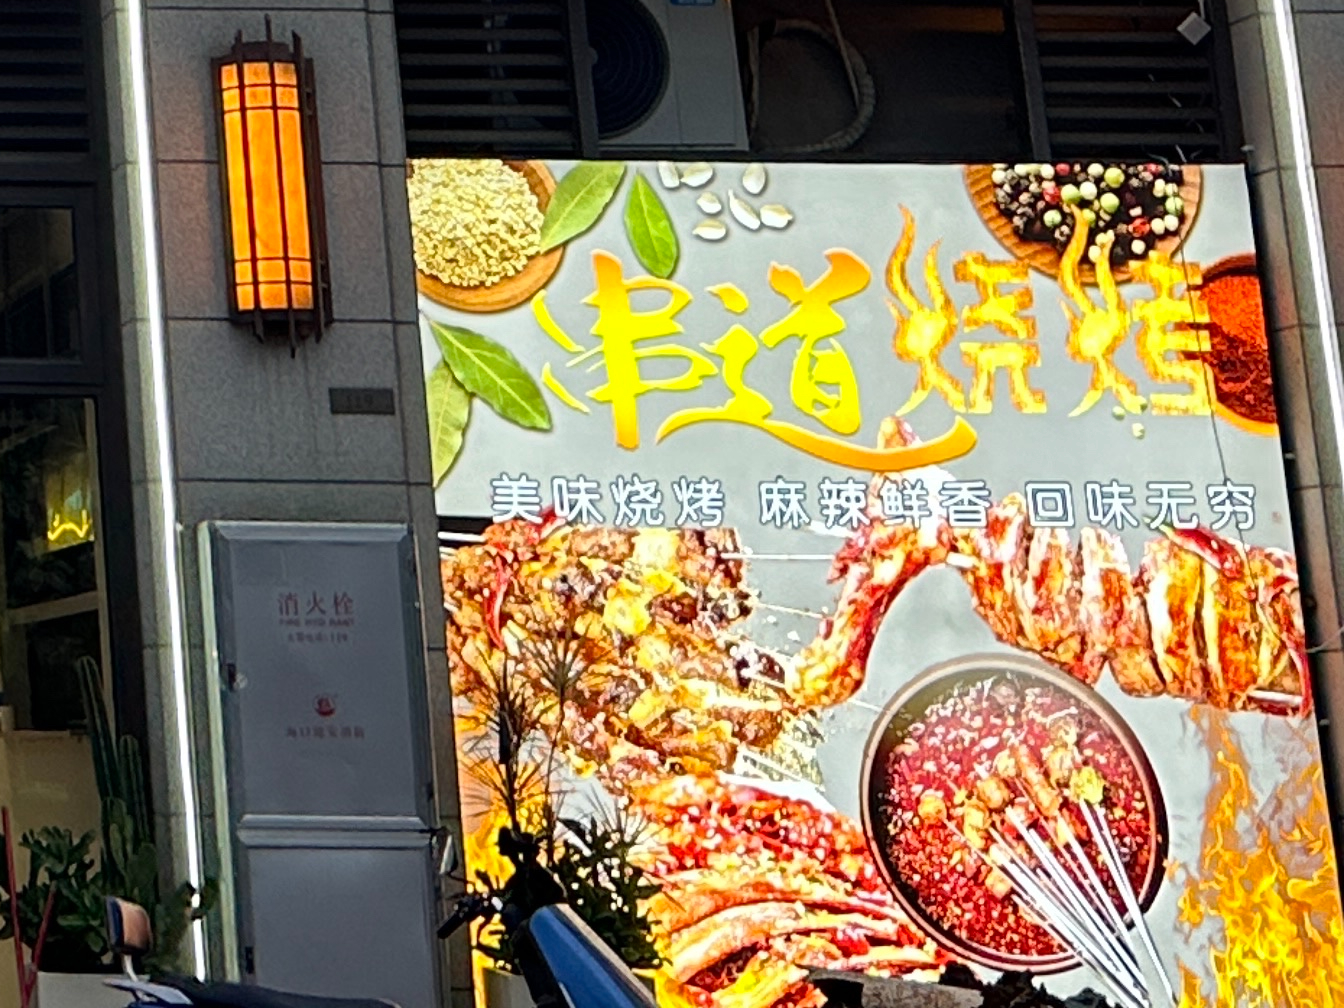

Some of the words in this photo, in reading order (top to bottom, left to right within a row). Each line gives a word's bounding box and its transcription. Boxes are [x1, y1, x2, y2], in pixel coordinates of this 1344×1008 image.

[529, 203, 1213, 472] 串道烧烤
[489, 473, 726, 529] 美味烧烤
[758, 476, 991, 530] 麻辣鲜香
[1026, 480, 1258, 532] 回味无穷
[277, 590, 354, 617] 消火栓
